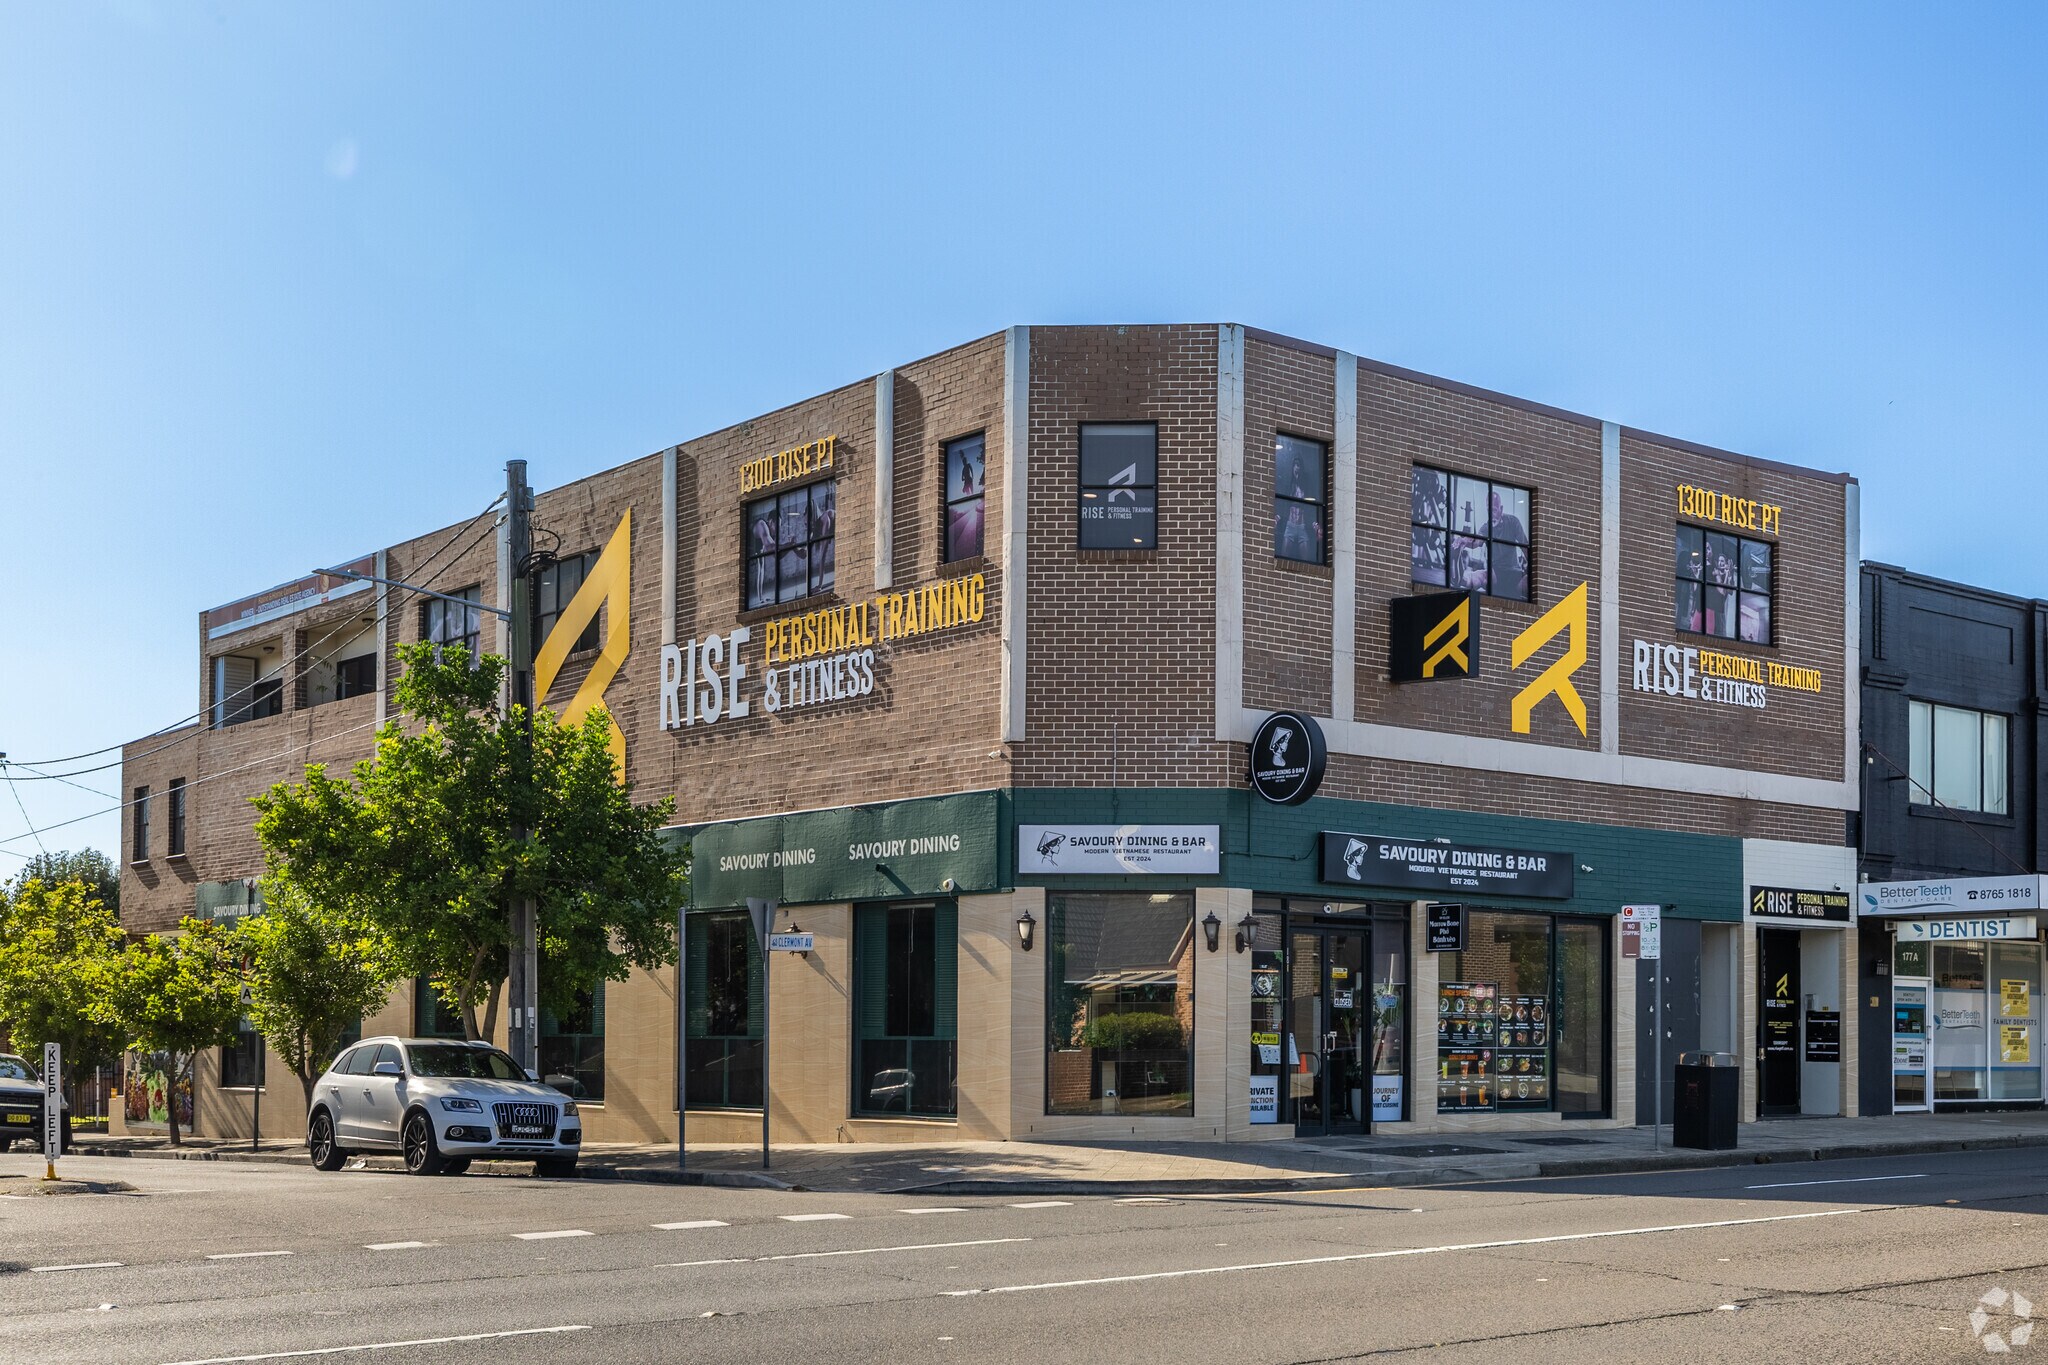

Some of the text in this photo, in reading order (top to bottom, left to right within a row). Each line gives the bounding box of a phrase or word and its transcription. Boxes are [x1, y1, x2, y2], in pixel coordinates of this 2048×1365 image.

[740, 434, 836, 495] 1300 RISE PT
[1082, 507, 1104, 519] RISE
[1676, 484, 1782, 536] 1300 RISE PT
[765, 573, 985, 665] PERSONAL TRAINING
[660, 626, 750, 731] RISE
[1633, 639, 1697, 699] RISE
[1700, 650, 1821, 693] PERSONAL TRAINING
[764, 648, 874, 713] & FITNESS
[1701, 677, 1766, 708] & FITNESS
[849, 834, 960, 861] SAVOURY DINING
[1070, 836, 1206, 846] SAVOURY DINING & BAR
[720, 848, 816, 872] SAVOURY DINING
[1379, 844, 1547, 872] SAVOURY DINING & BAR
[1408, 864, 1518, 880] MODERN VIETNAMESE RESTAURANT
[1463, 878, 1479, 886] 2024
[1797, 893, 1847, 907] PERSONAL TRAINING
[1881, 884, 2031, 900] BetterTeeth 8765 1818
[213, 904, 239, 917] SAVOURY
[1768, 891, 1793, 914] RISE
[1797, 905, 1824, 916] & FITNESS
[1930, 920, 2010, 938] DENTIST
[1902, 952, 1918, 962] 177A
[1334, 998, 1352, 1007] CLOSED
[1942, 1009, 1980, 1019] BetterTeeth
